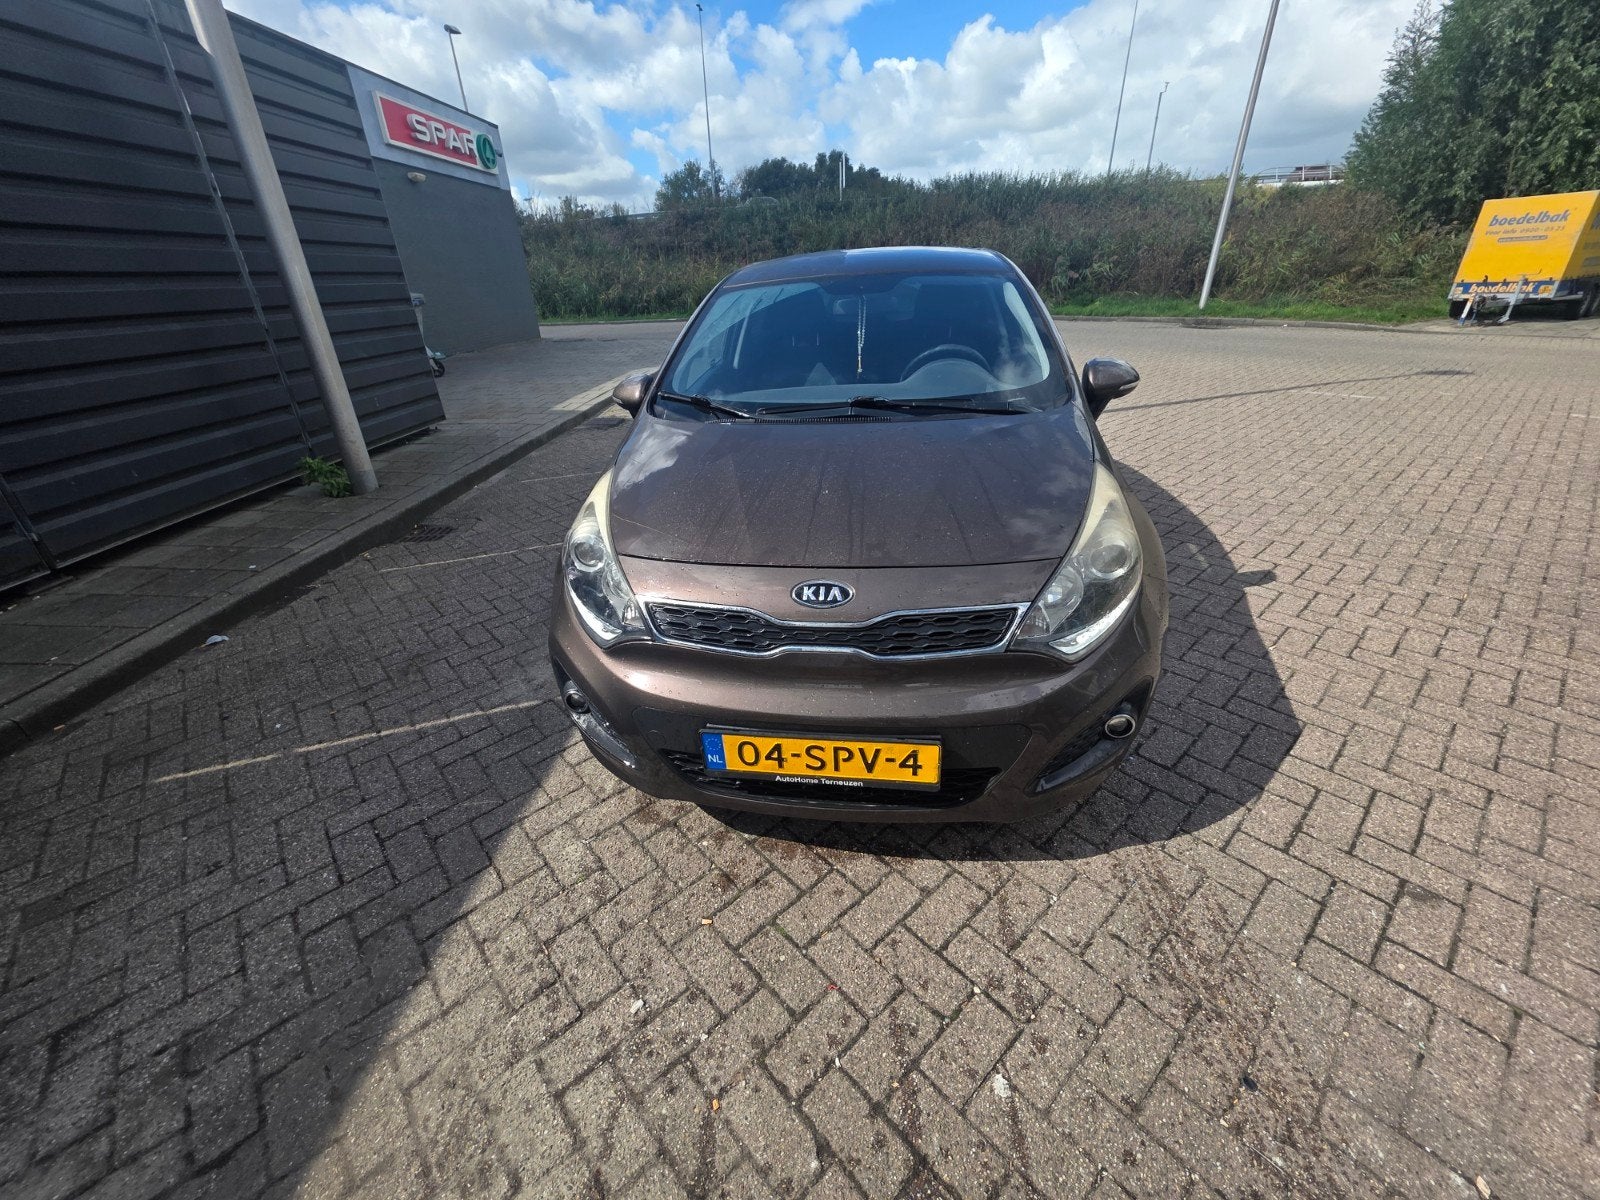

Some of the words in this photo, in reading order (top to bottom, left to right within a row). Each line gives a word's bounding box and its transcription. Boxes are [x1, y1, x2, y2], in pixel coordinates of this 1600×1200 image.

[406, 113, 477, 156] SPAR
[1488, 209, 1571, 227] boedelbak
[802, 586, 842, 601] KIA
[708, 754, 723, 763] NL
[737, 740, 923, 776] 04-SPV-4
[775, 775, 819, 784] AutoHome
[820, 778, 864, 787] Terneuzen
